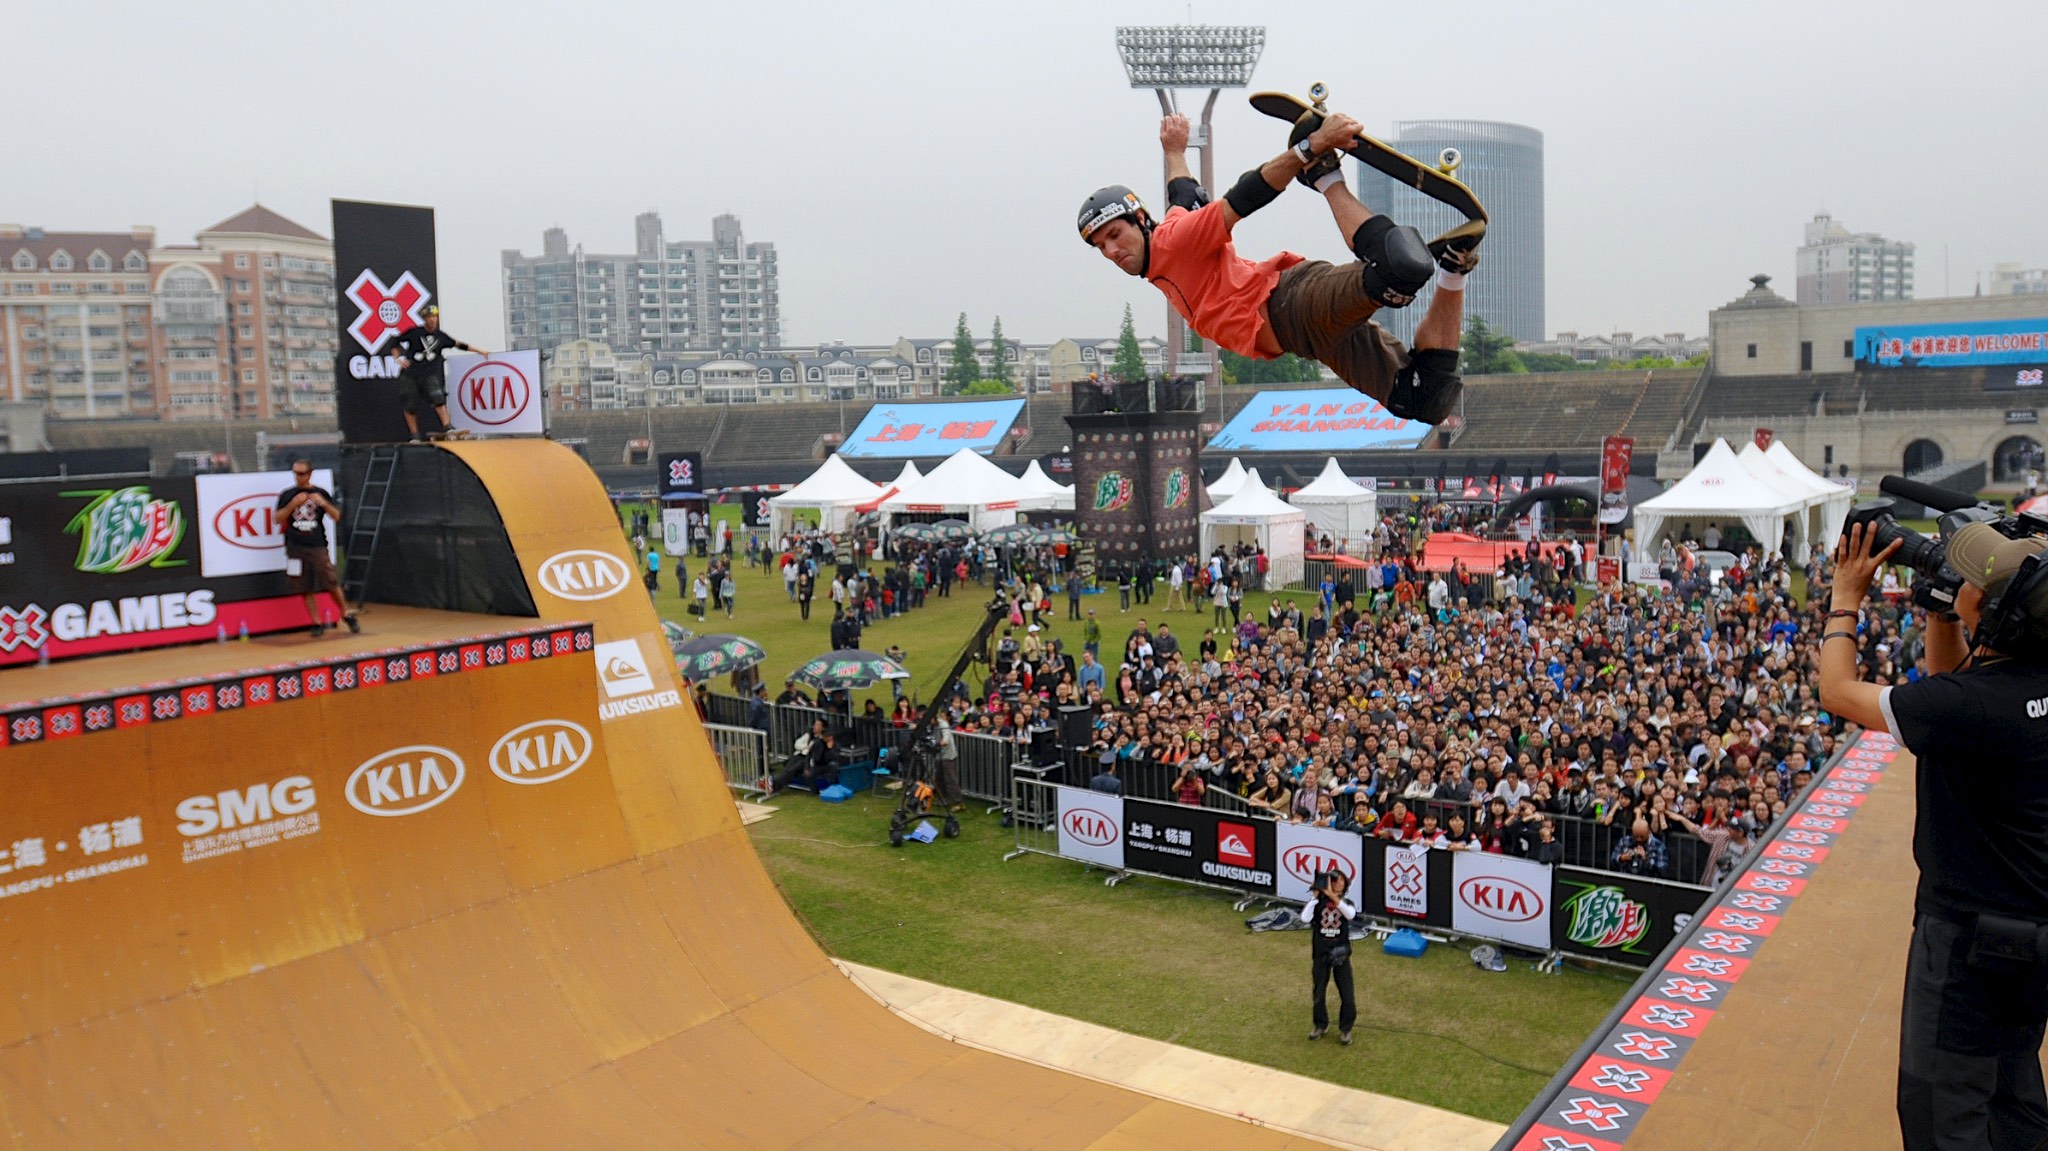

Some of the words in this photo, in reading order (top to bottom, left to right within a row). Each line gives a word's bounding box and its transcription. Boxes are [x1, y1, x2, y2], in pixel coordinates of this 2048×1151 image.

[1974, 333, 2040, 351] WELCOME
[468, 375, 517, 411] KIA
[1252, 416, 1408, 432] SHANGHAI
[550, 559, 619, 592] KIA
[51, 589, 216, 641] GAMES
[2026, 696, 2048, 720] QU
[505, 730, 578, 775] KIA
[364, 757, 448, 806] KIA
[175, 775, 317, 836] SMG
[182, 843, 241, 864] SHANGHAI
[282, 824, 320, 840] GROUP
[1072, 815, 1109, 840] KIA
[1202, 860, 1273, 887] QUIKSILVER
[1391, 894, 1422, 906] GAMES
[1473, 882, 1530, 915] KIA
